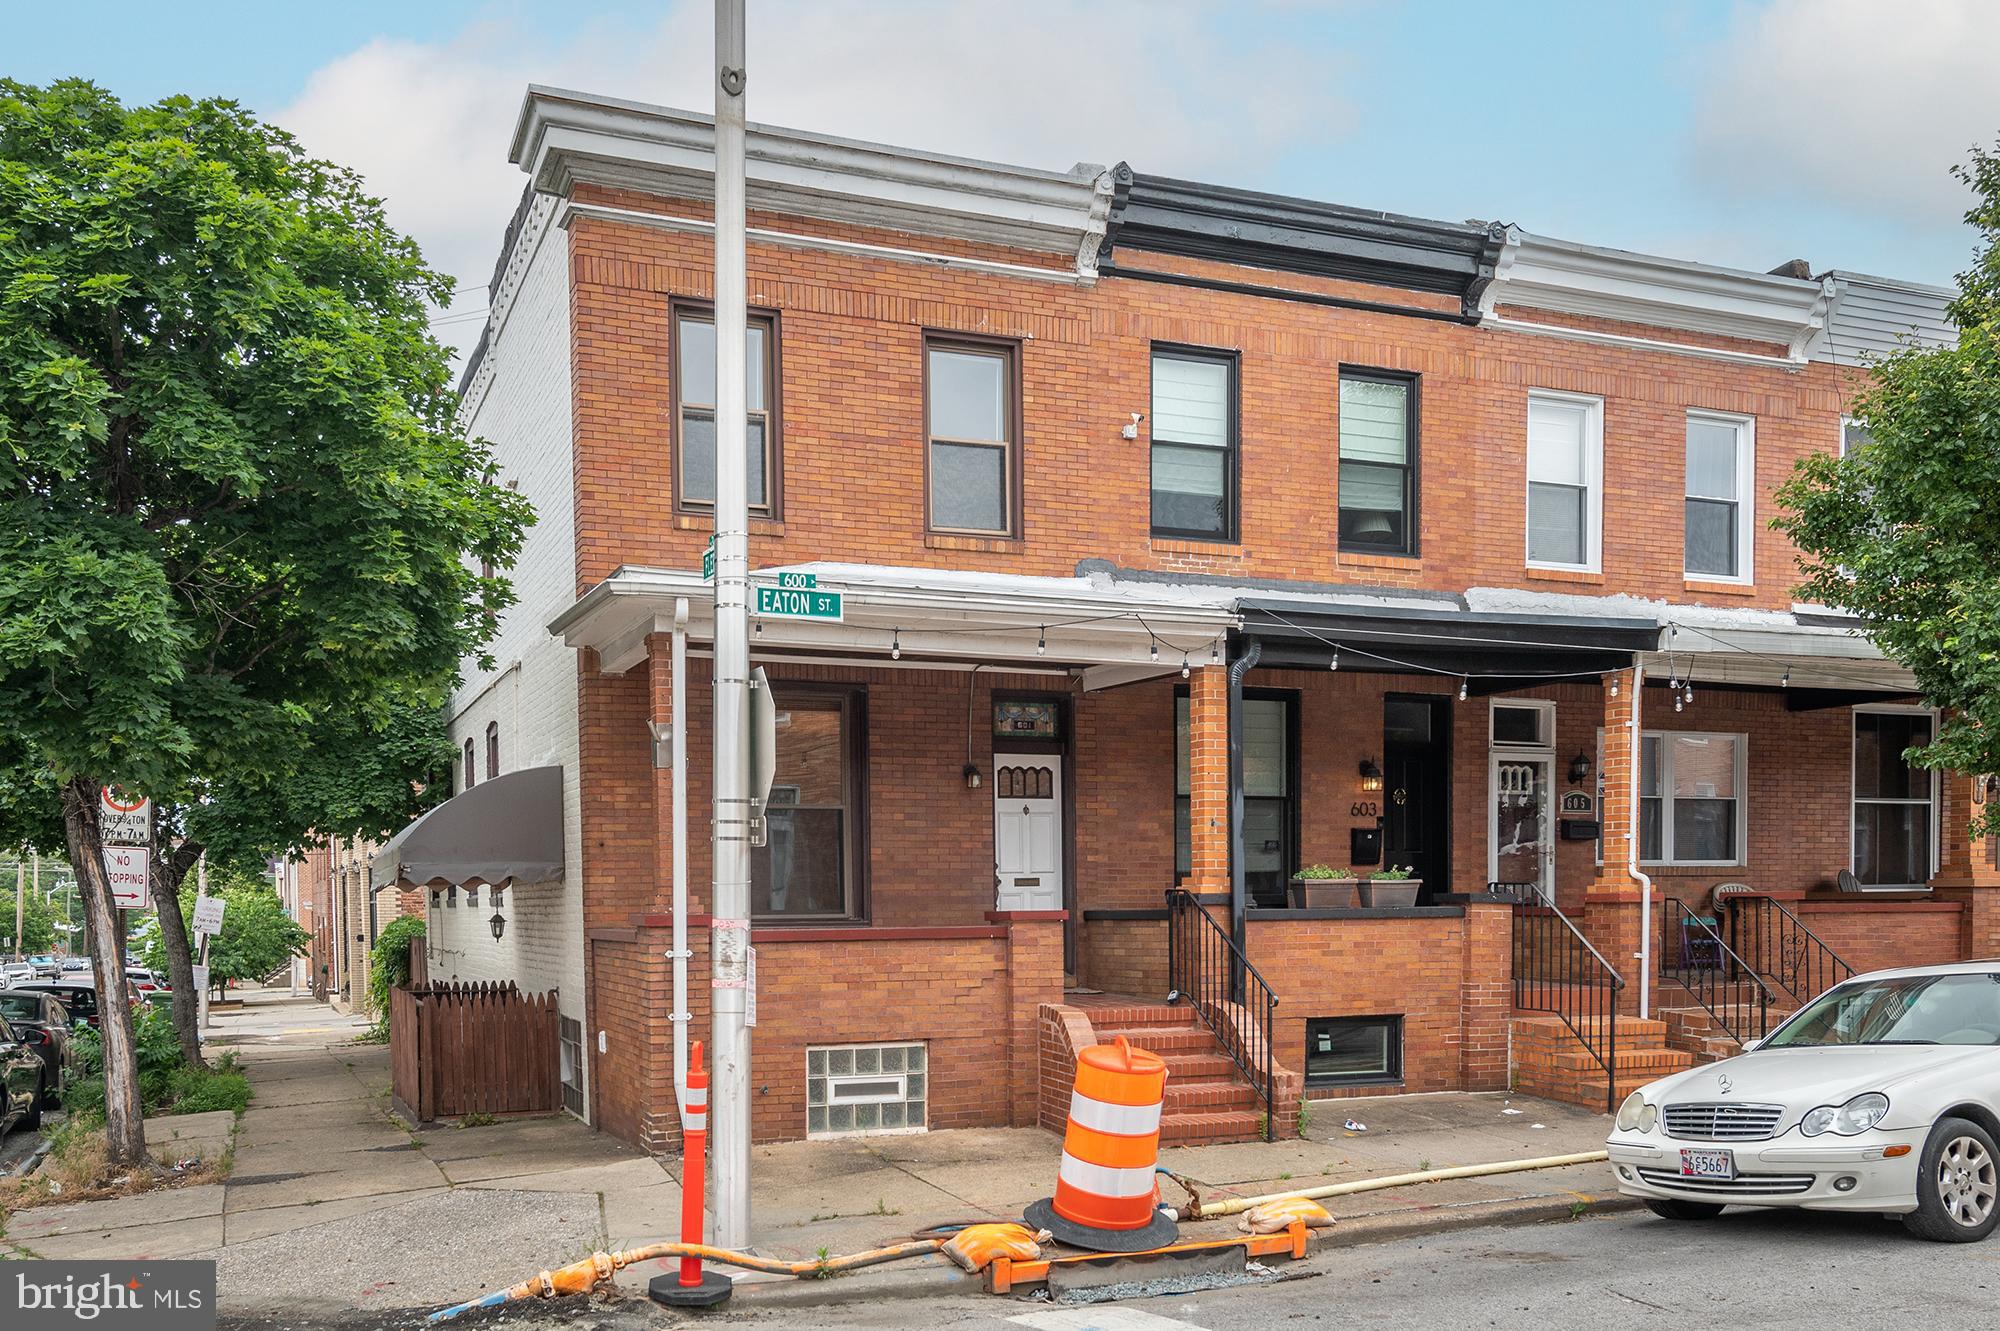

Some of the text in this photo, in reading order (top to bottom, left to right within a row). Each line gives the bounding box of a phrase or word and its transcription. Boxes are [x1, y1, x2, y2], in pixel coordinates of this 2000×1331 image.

[784, 573, 807, 588] 600
[762, 590, 833, 614] EATON ST.
[1351, 801, 1377, 817] 603
[1567, 797, 1585, 809] 605
[132, 815, 146, 825] TON
[116, 855, 130, 867] NO
[108, 872, 144, 885] TOPPING
